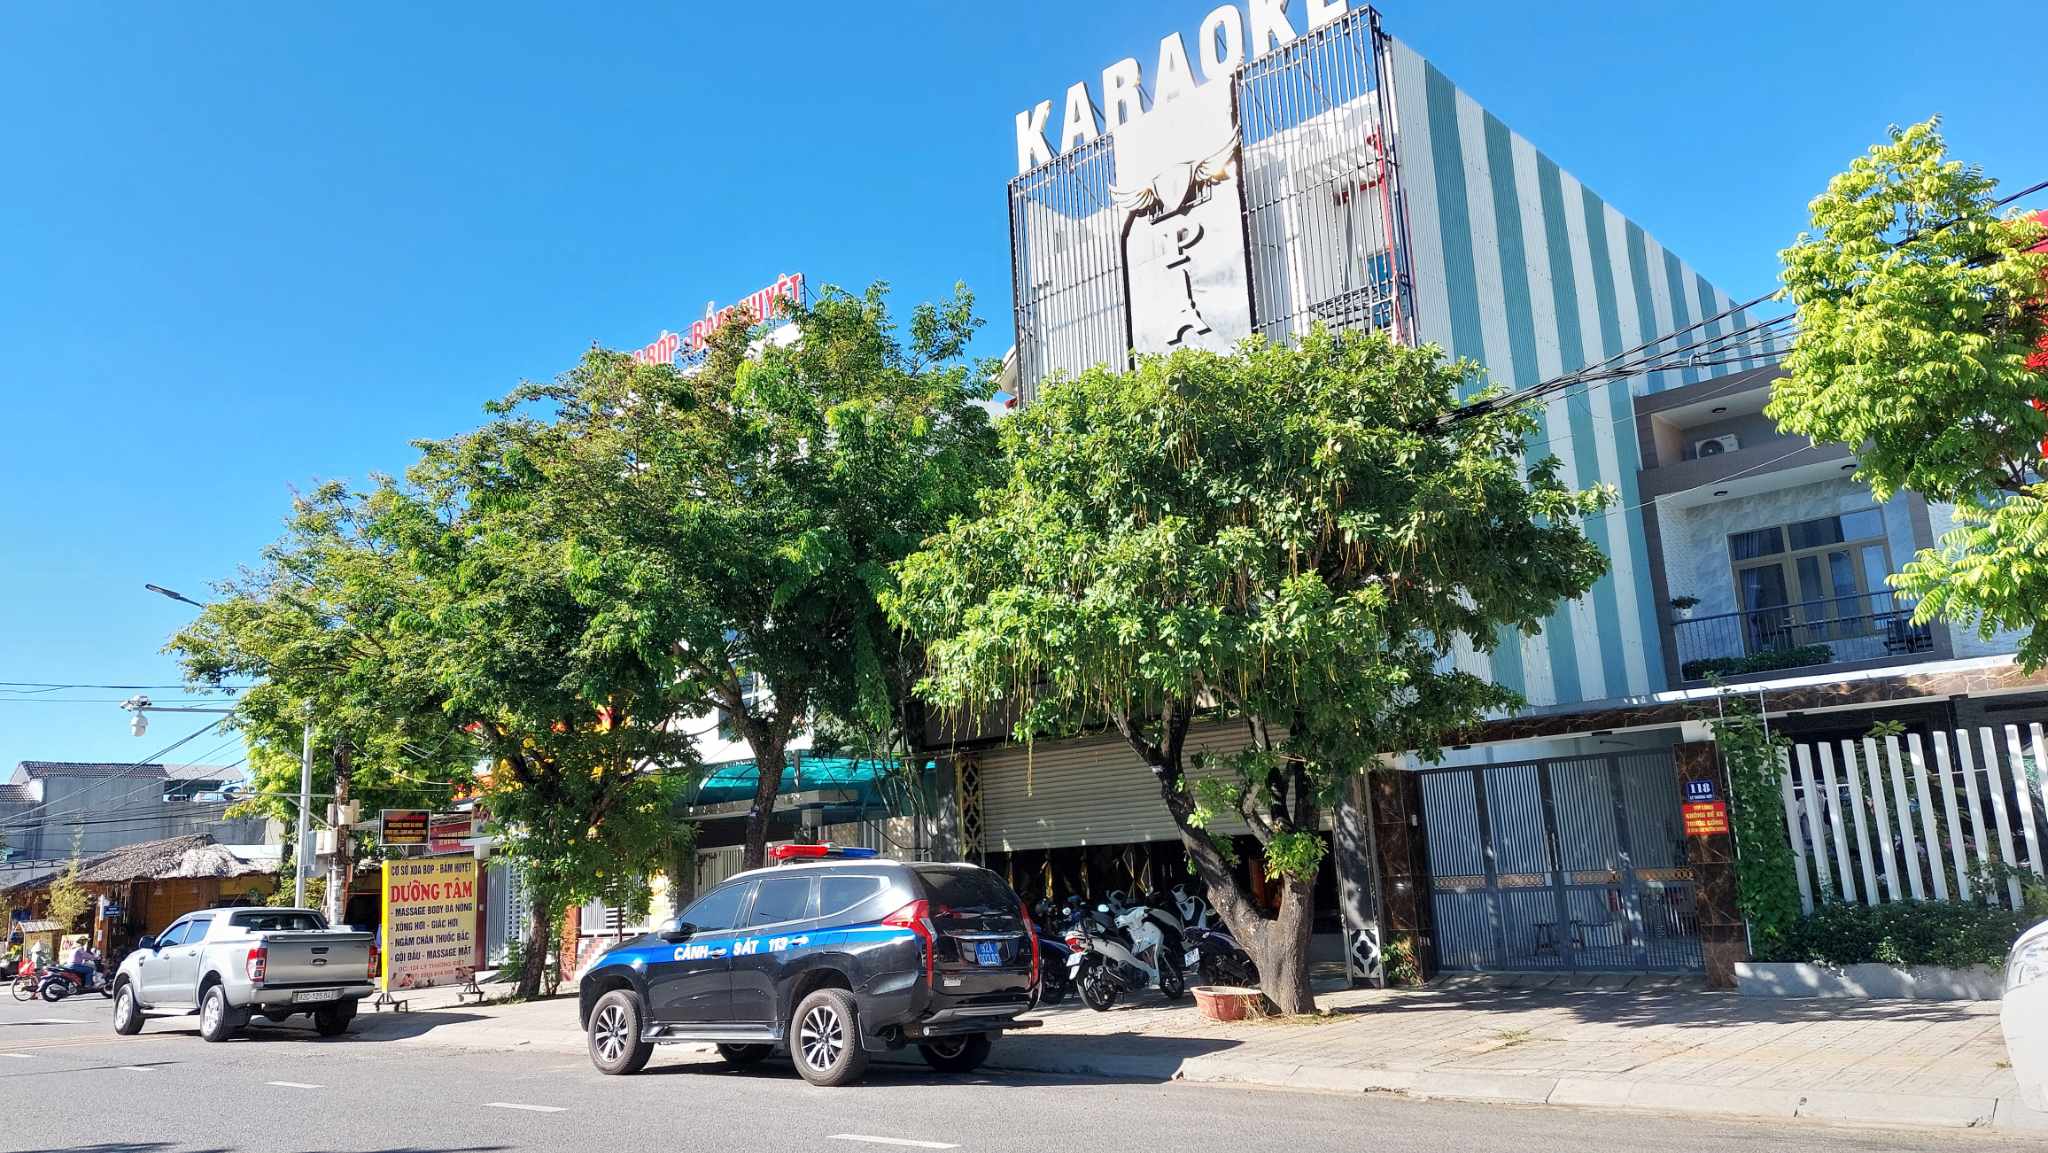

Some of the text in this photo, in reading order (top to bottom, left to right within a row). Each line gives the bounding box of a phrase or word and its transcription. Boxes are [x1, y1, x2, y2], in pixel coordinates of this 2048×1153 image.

[1015, 0, 1349, 174] KARAOK
[1689, 783, 1711, 794] 118
[391, 877, 473, 903] DƯỠNG TÂM
[395, 906, 426, 917] MASSAGE
[427, 905, 444, 915] BODY
[427, 948, 457, 960] MASSAGE
[673, 942, 709, 960] CẢNH
[733, 937, 760, 956] SÁT
